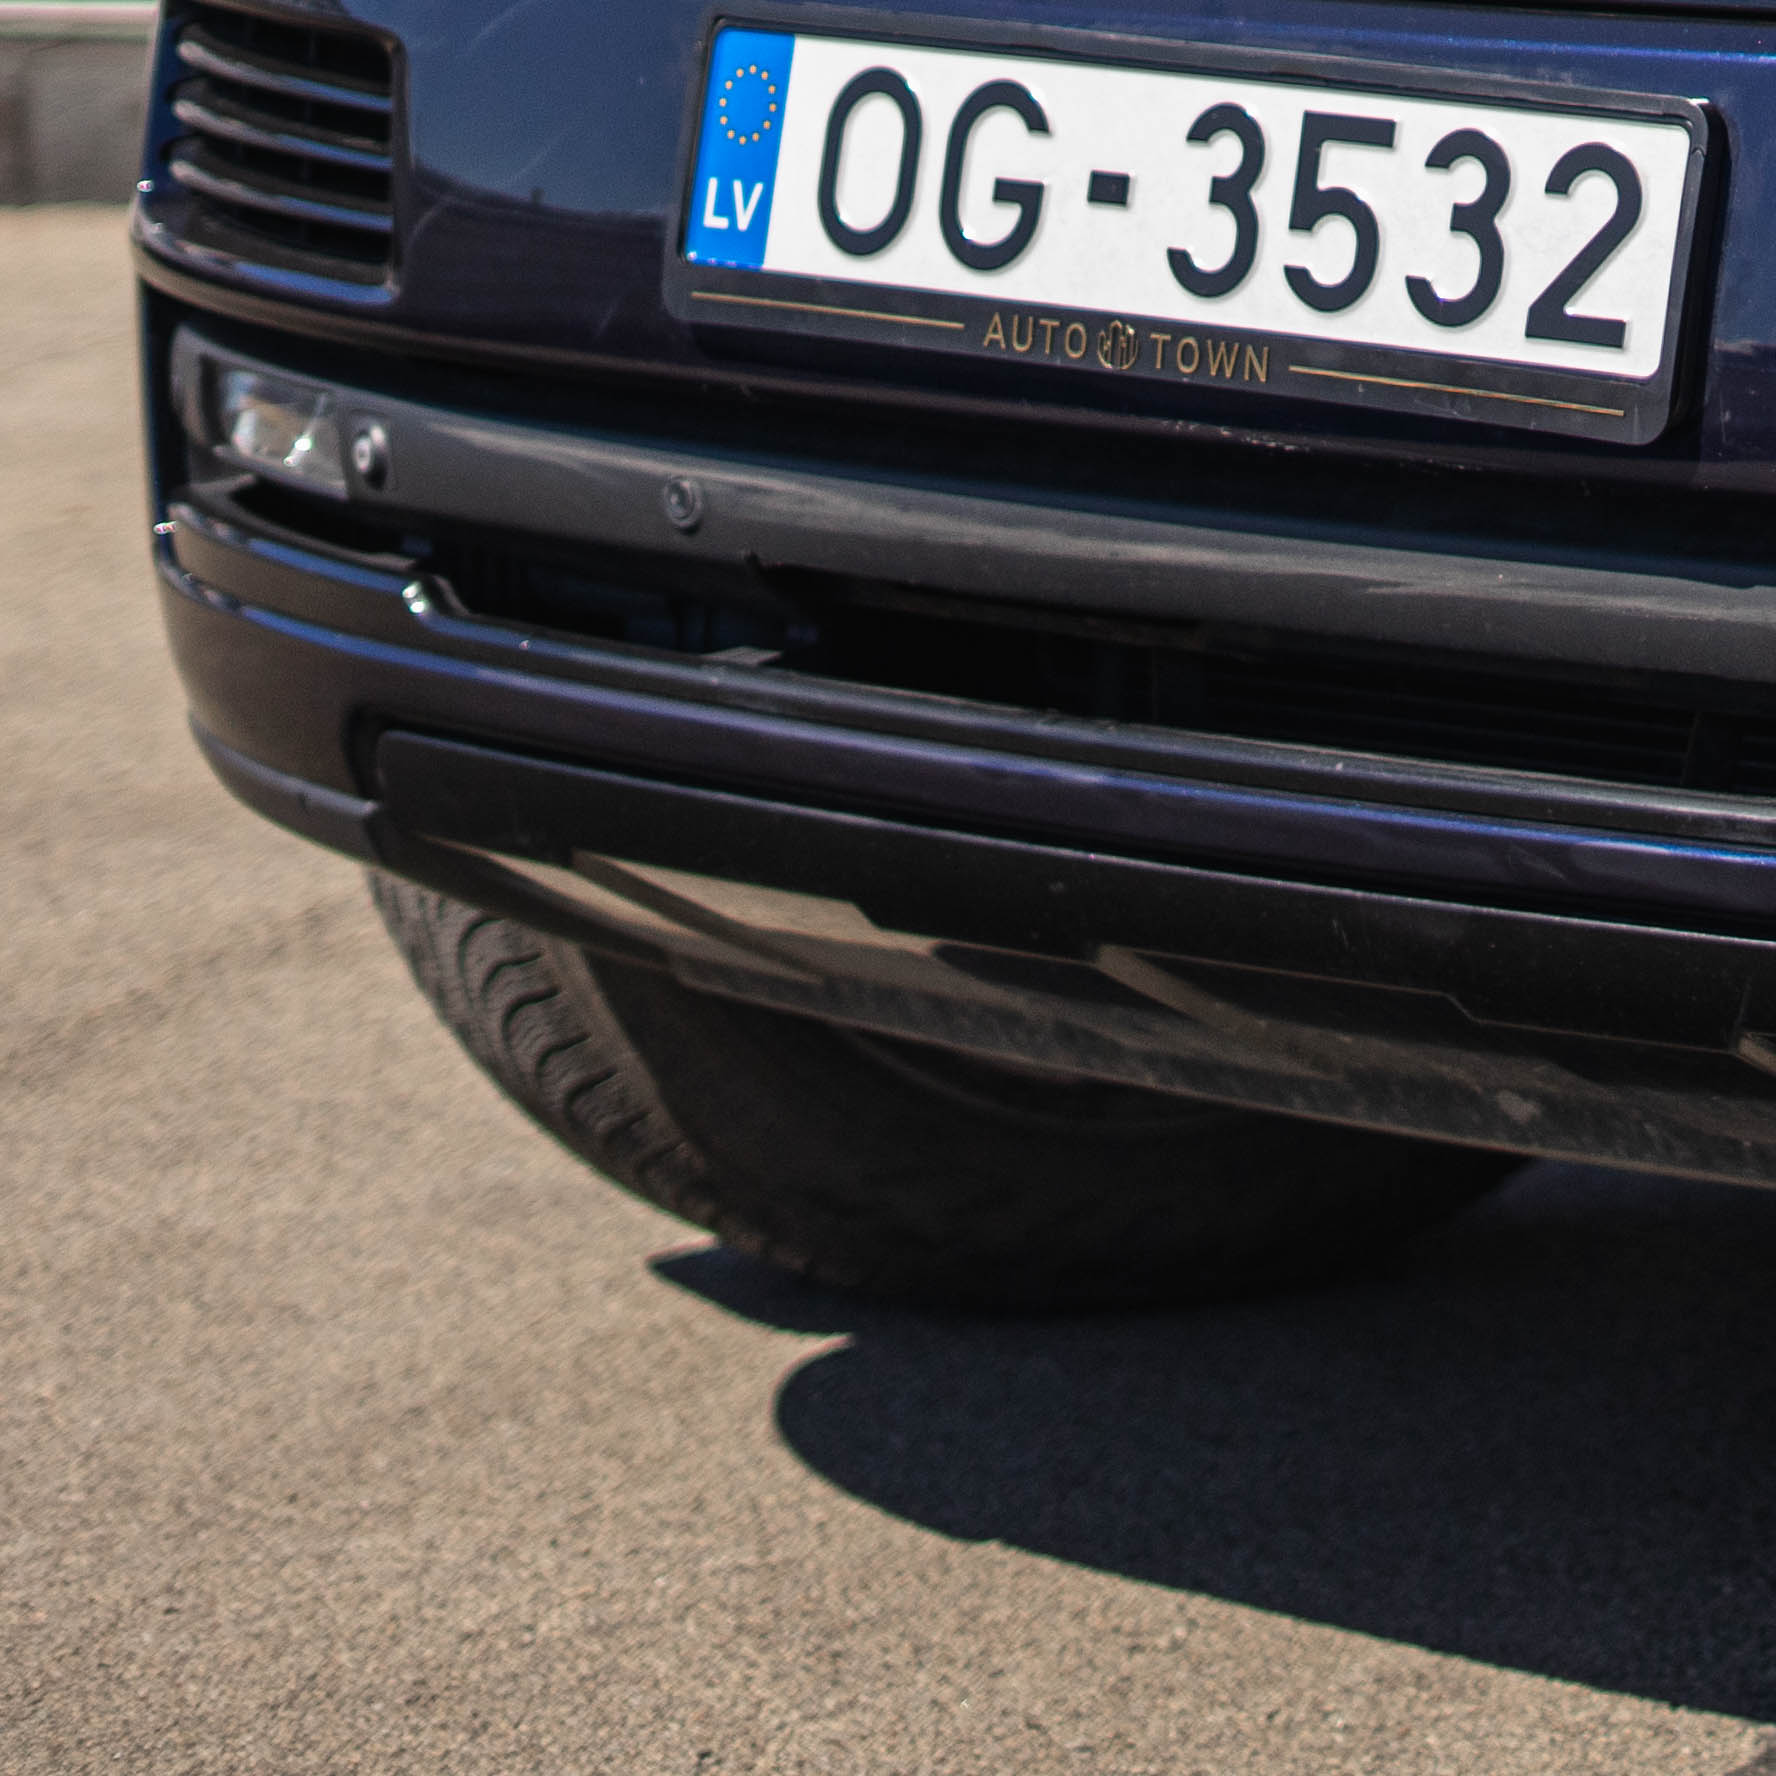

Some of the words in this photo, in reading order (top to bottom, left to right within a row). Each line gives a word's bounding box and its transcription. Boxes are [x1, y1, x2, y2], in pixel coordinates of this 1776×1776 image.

[703, 177, 763, 232] LV
[817, 66, 1643, 349] OG-3532
[984, 312, 1087, 360] AUTO
[1150, 332, 1269, 383] TOWN
